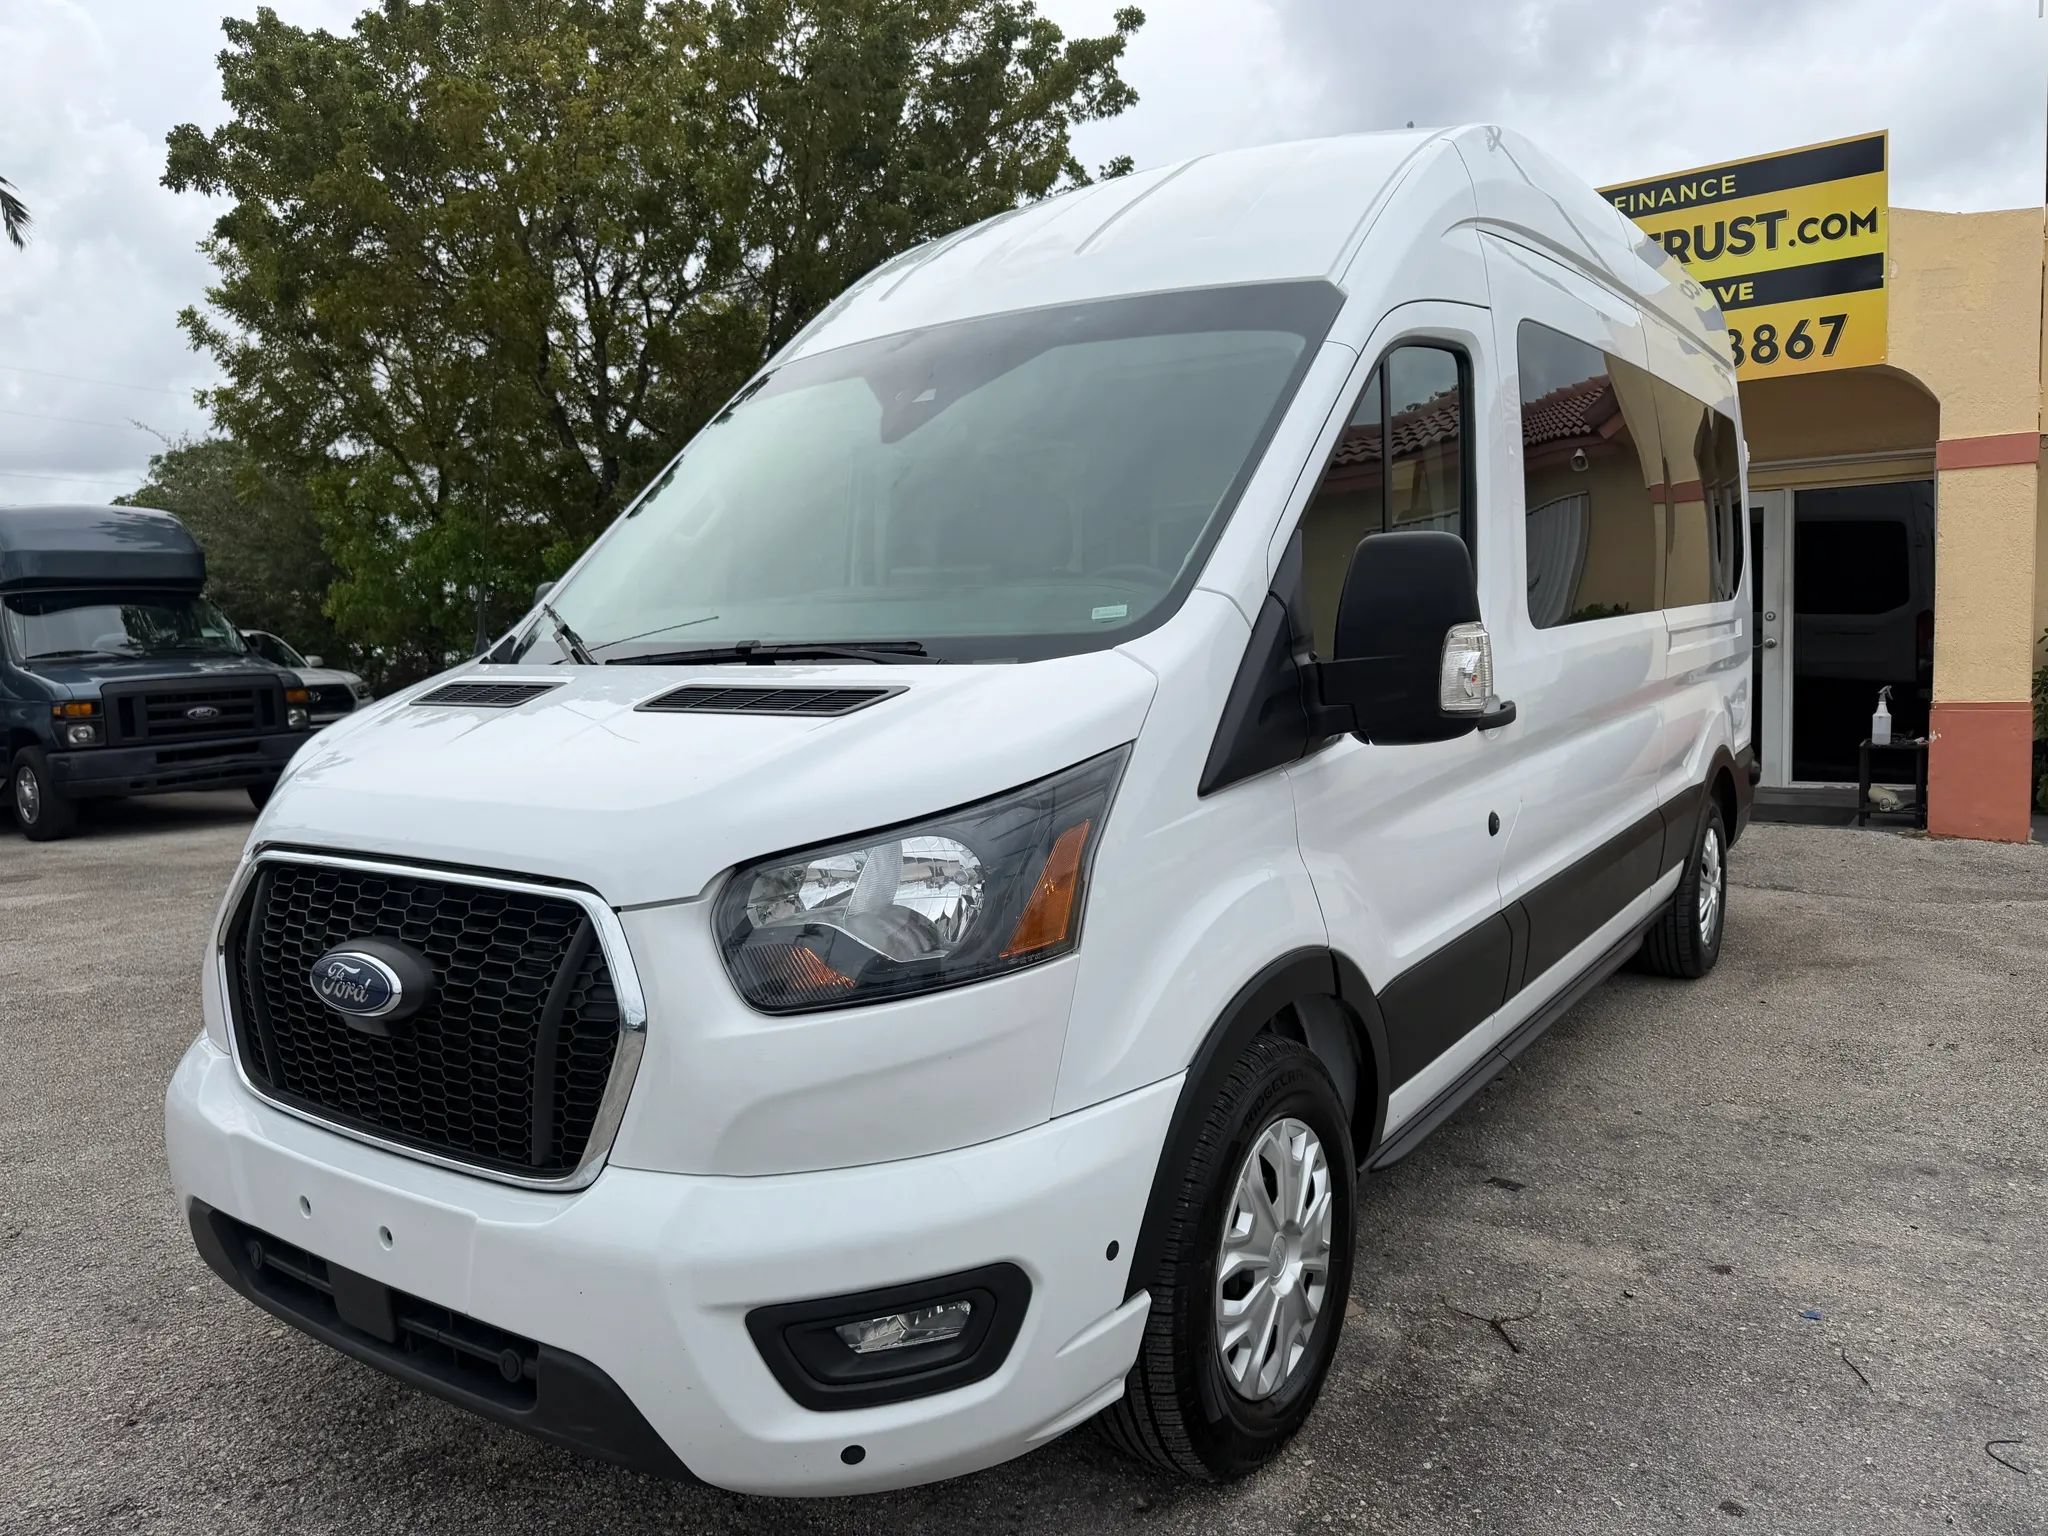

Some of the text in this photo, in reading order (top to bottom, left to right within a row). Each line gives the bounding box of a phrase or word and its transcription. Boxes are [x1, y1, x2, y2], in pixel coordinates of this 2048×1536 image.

[1614, 174, 1737, 212] FINANCE
[1648, 207, 1877, 264] RUST.COM
[1707, 282, 1754, 303] VE
[321, 962, 372, 1003] Ford
